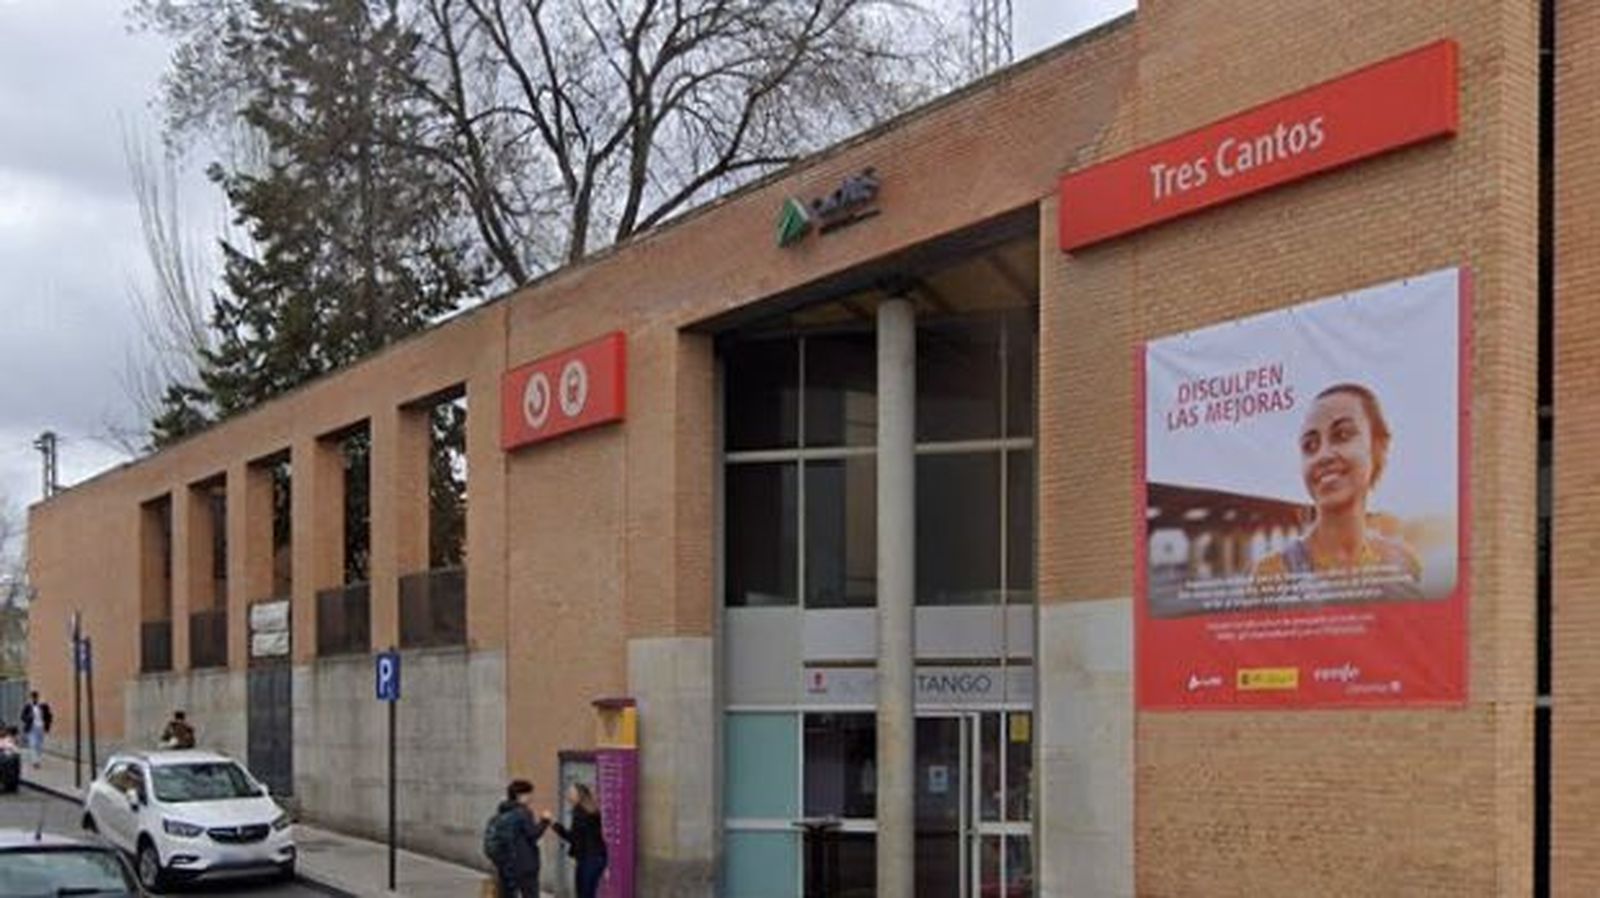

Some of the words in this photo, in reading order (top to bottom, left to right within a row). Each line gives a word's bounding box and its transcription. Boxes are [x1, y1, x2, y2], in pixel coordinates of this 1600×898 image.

[1149, 156, 1208, 199] Tres
[1216, 115, 1325, 178] Cantos
[1177, 361, 1284, 404] DISCULPEN
[1167, 405, 1199, 431] LAS
[1205, 385, 1296, 425] MEJORAS
[379, 657, 393, 695] P
[915, 673, 992, 693] TANGO
